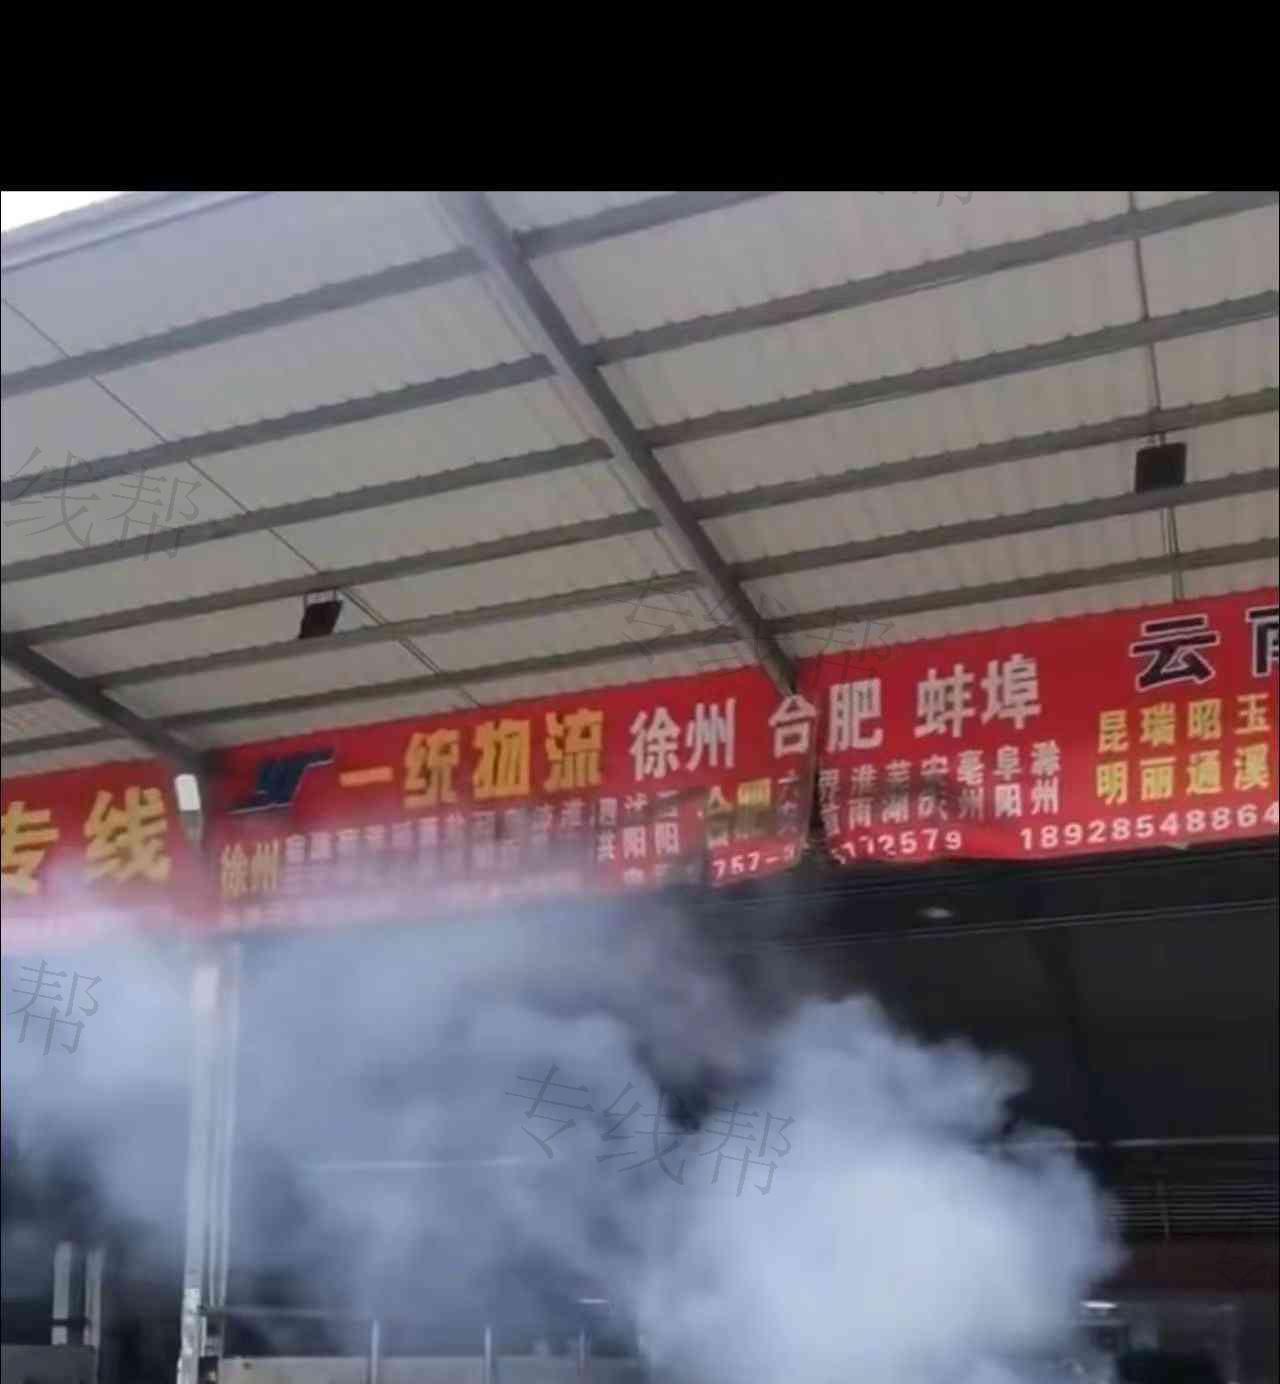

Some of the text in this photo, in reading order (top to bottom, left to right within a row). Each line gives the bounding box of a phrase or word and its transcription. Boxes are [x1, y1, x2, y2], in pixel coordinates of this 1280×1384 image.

[338, 653, 1042, 810] 一统物流 徐州 合肥 蚌埠
[0, 786, 173, 896] 专线
[1020, 800, 1280, 850] 18928548864
[219, 839, 280, 899] 徐州
